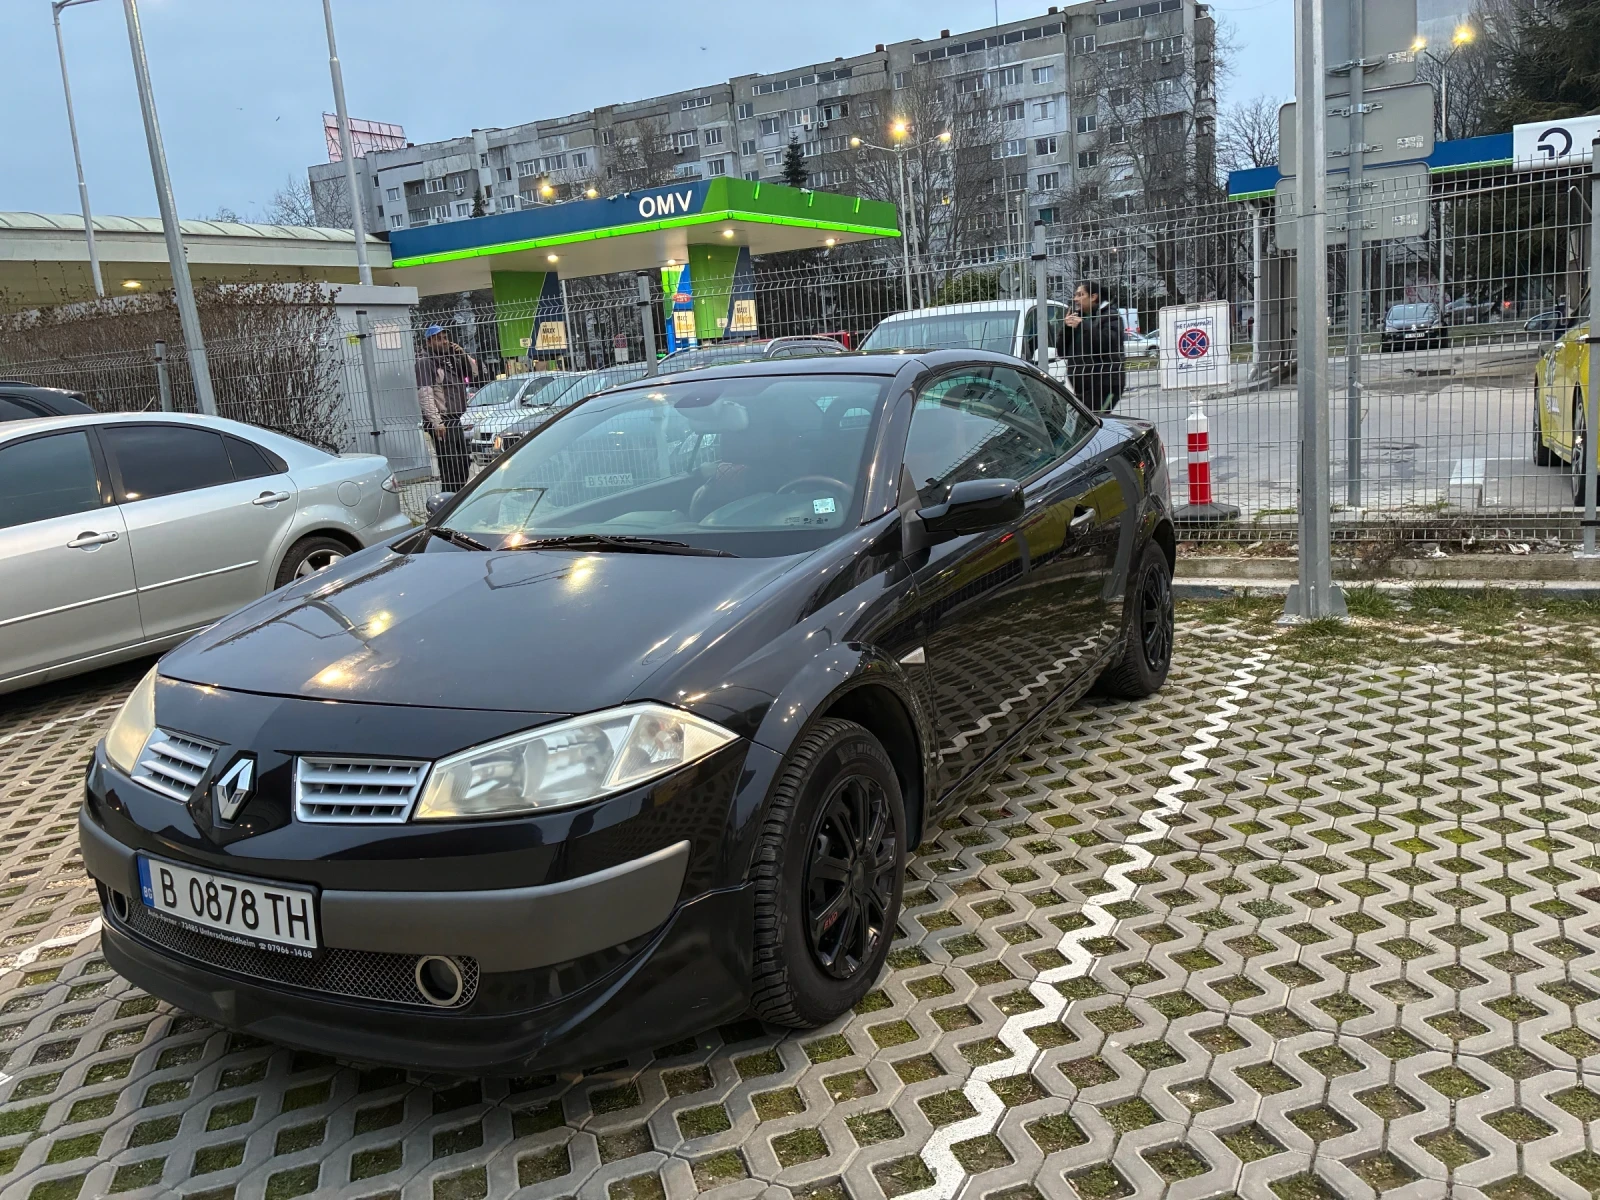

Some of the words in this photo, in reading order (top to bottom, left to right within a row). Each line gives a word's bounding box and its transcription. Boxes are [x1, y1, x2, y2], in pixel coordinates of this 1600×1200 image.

[639, 190, 692, 218] OMV
[857, 743, 891, 773] MICHELIN
[143, 886, 153, 899] BG
[160, 867, 177, 908] B
[189, 877, 259, 930] 0878
[264, 892, 310, 941] TH
[824, 911, 839, 931] EVO
[200, 927, 256, 948] Unterschneidheim
